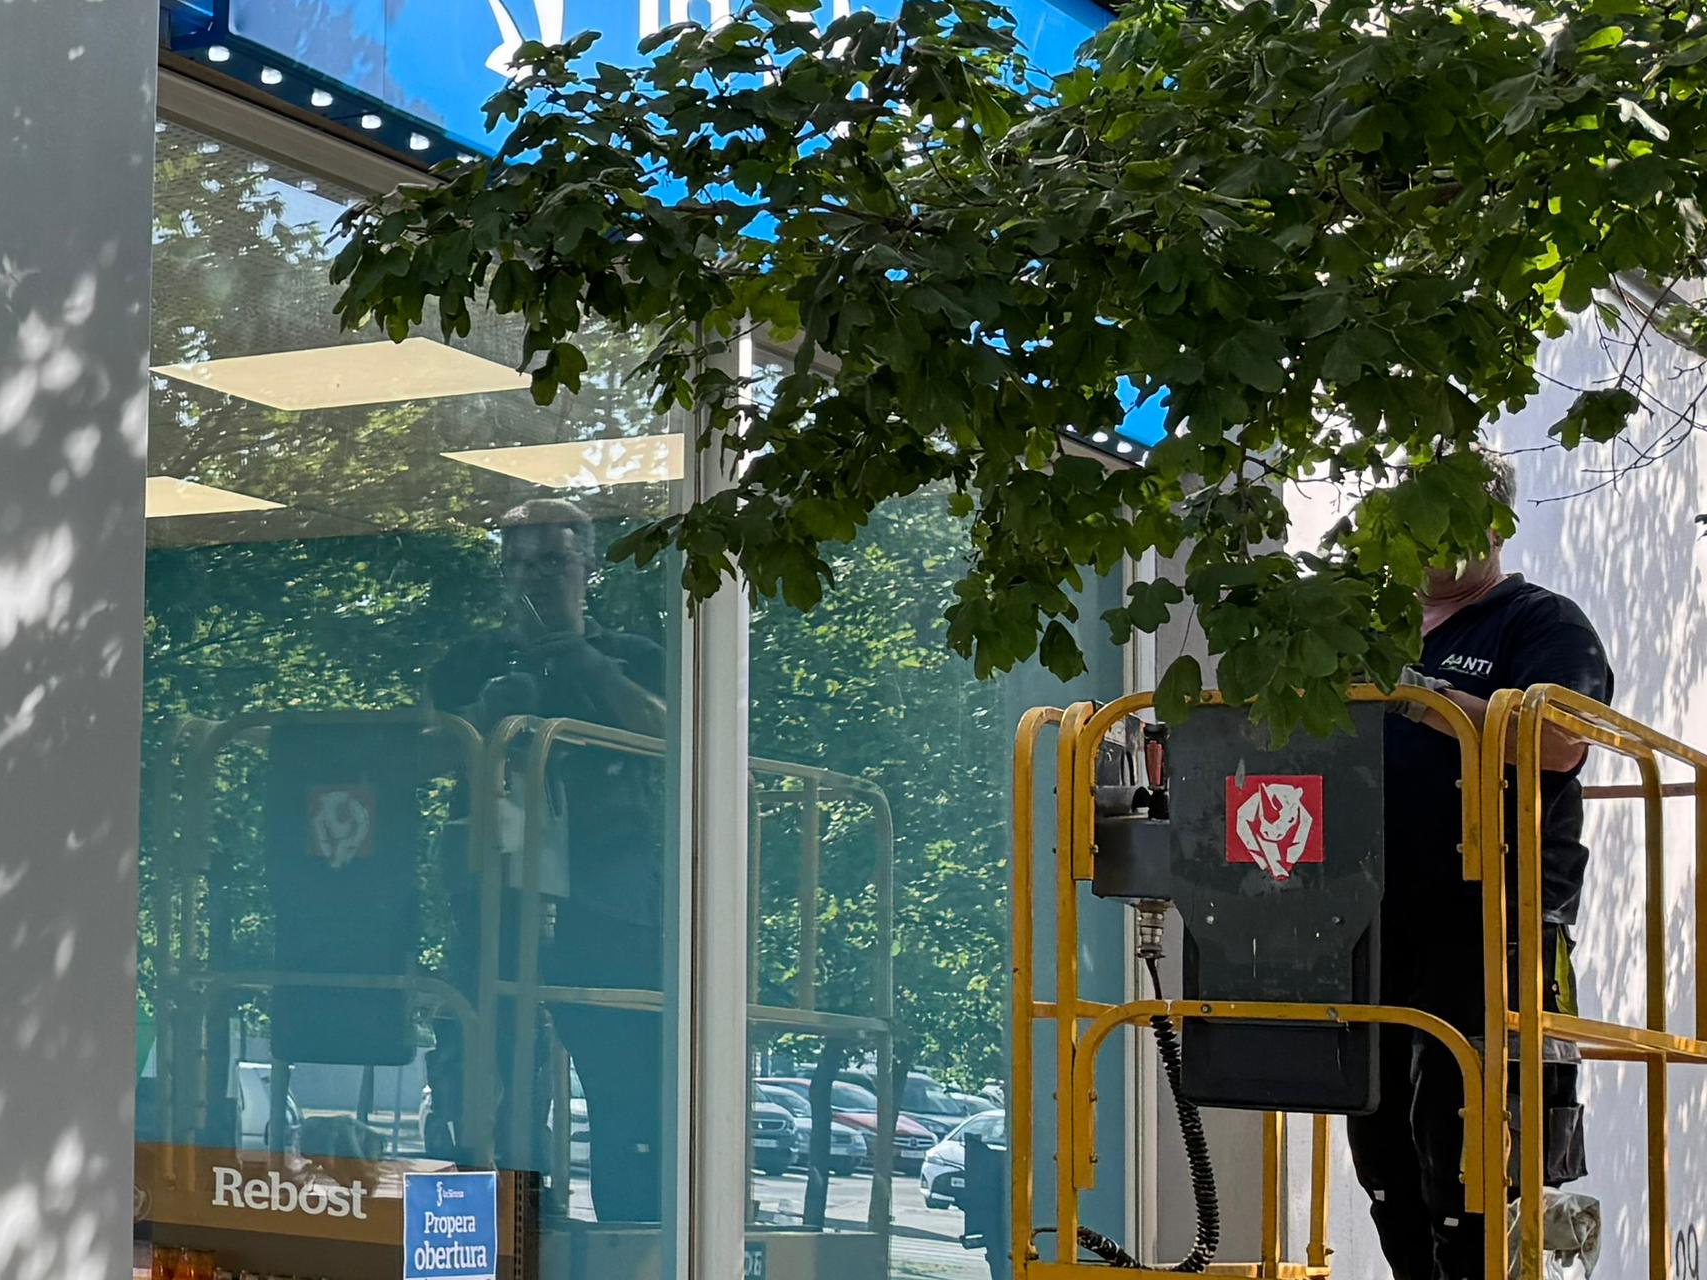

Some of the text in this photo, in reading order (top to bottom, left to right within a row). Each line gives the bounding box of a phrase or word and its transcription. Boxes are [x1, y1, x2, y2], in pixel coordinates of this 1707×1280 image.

[211, 1166, 368, 1220] Rebost
[423, 1211, 476, 1238] Propera
[414, 1240, 488, 1271] obertura
